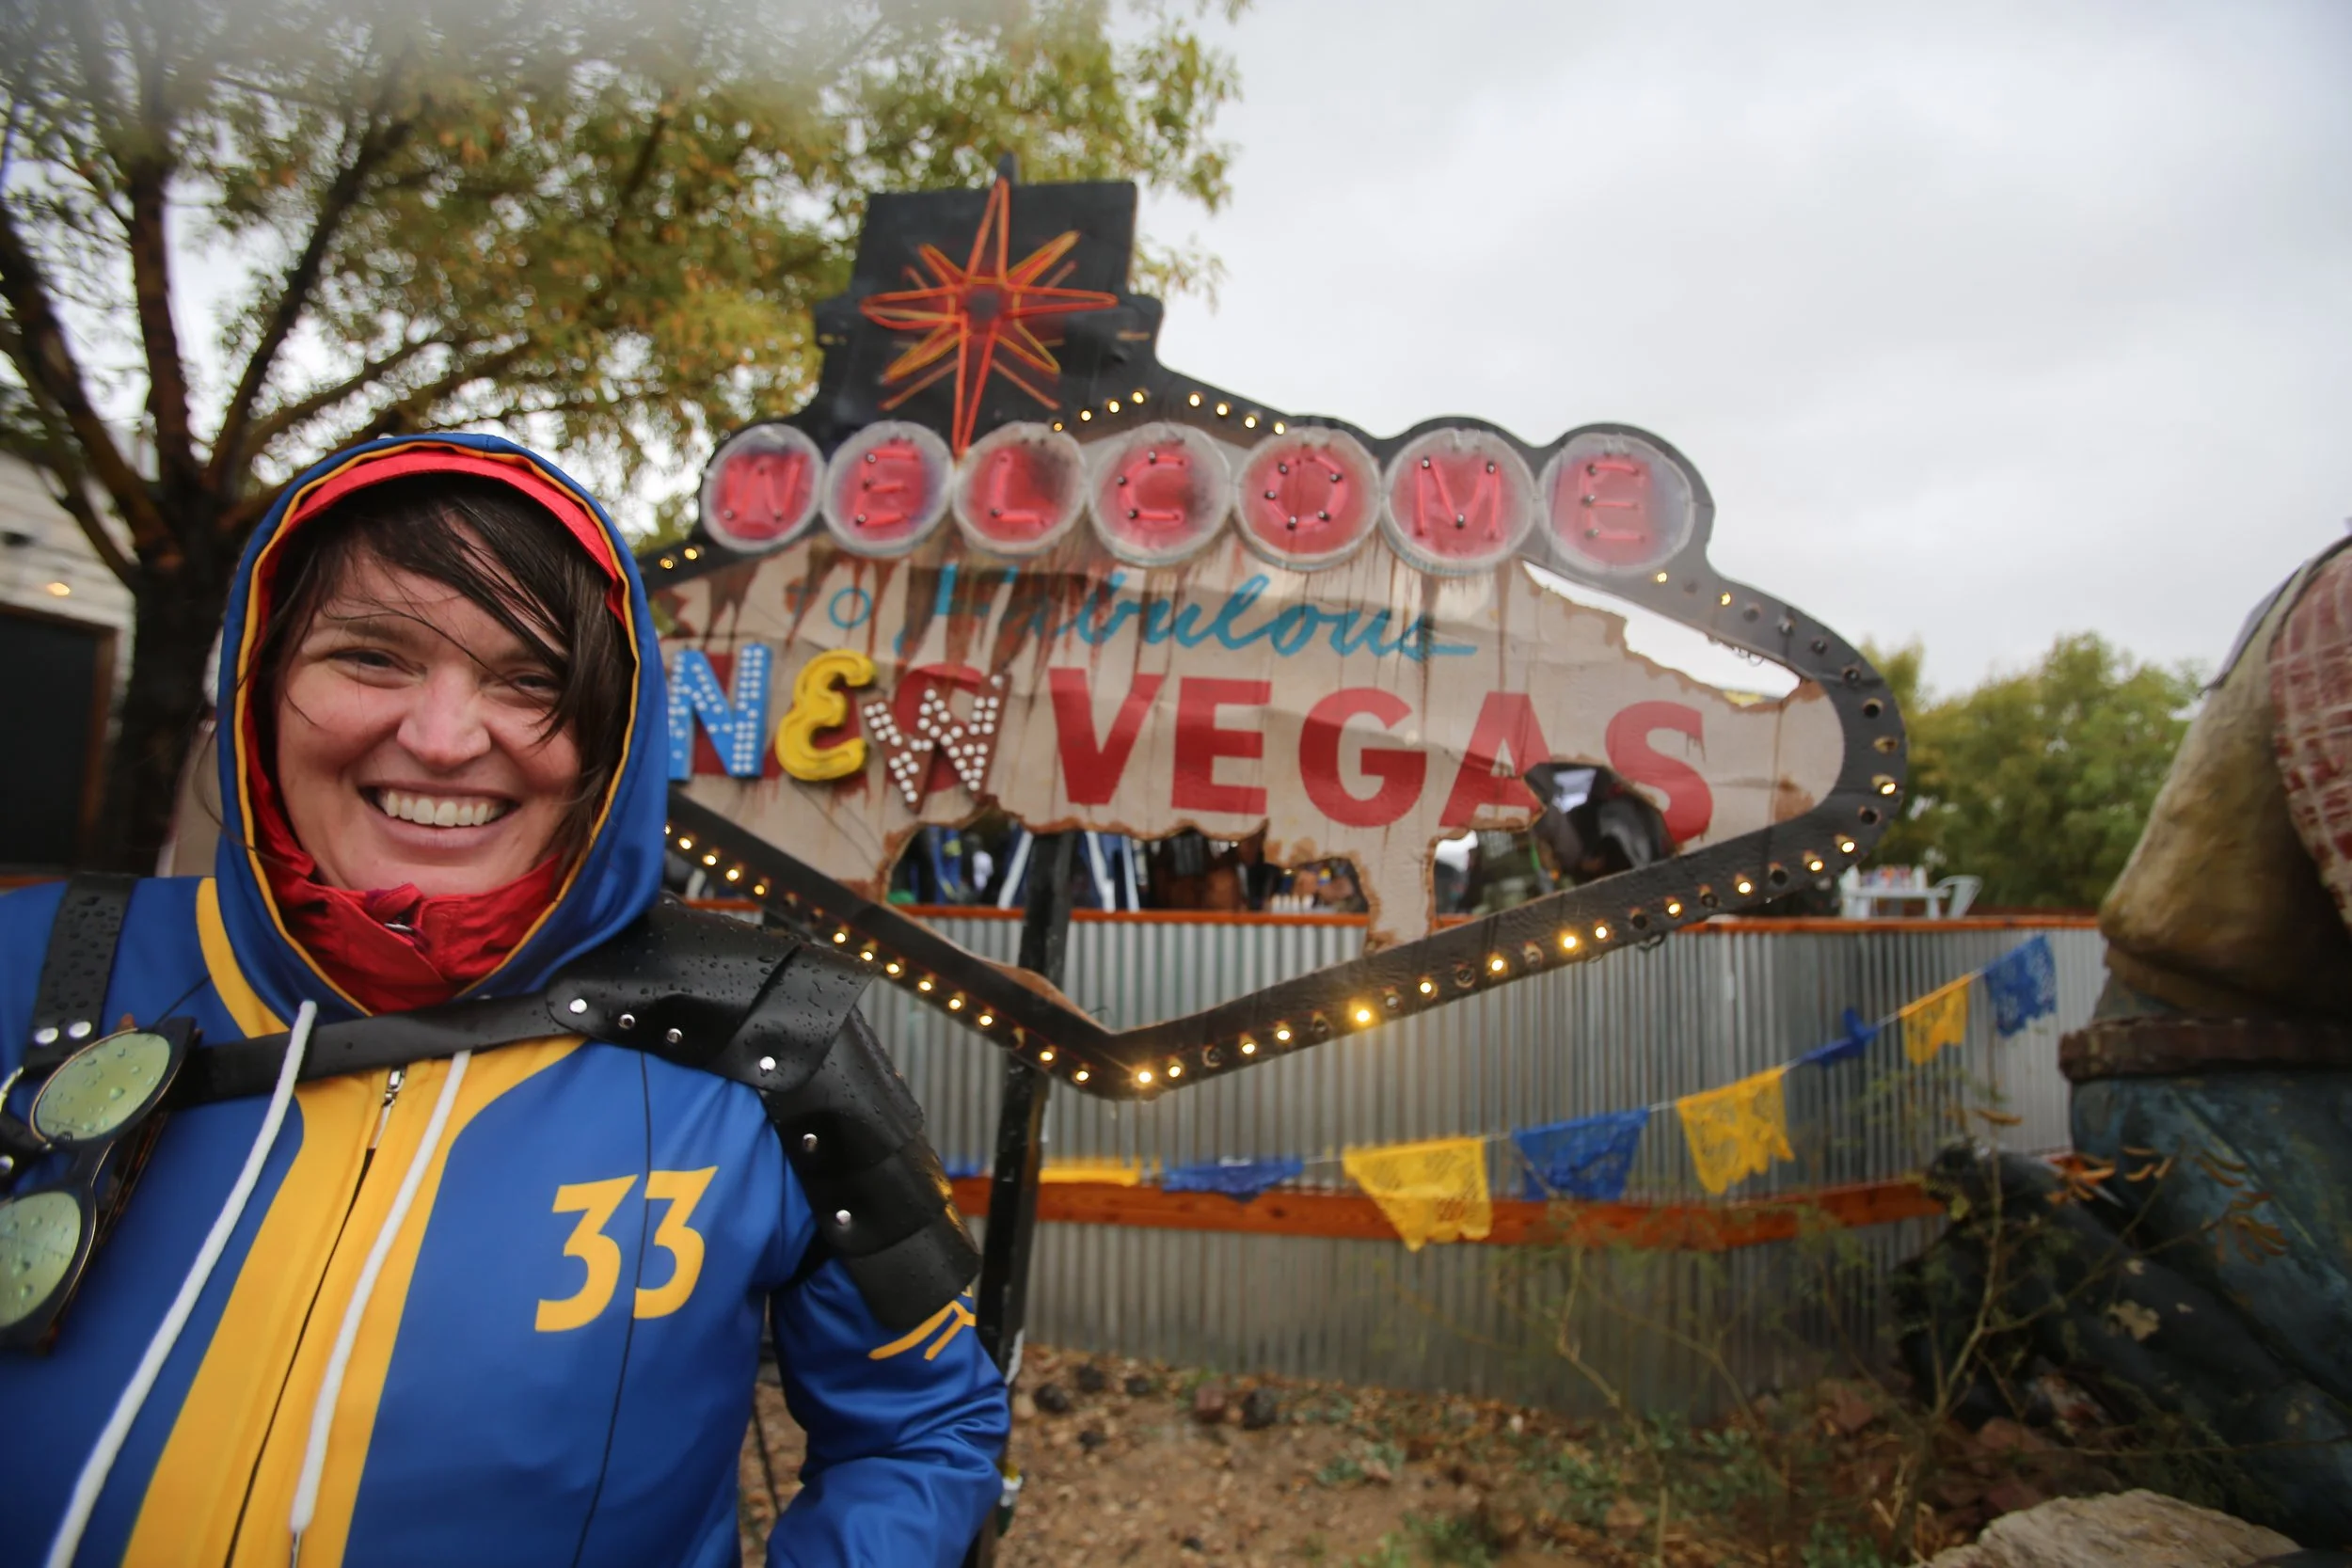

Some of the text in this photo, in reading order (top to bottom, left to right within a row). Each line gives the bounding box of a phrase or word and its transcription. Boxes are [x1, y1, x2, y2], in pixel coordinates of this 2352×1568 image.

[723, 440, 1646, 543] WELCOME
[786, 563, 1478, 662] o bulous
[668, 643, 1011, 815] NEW
[1049, 667, 1713, 847] VEGAS
[534, 1165, 719, 1332] 33
